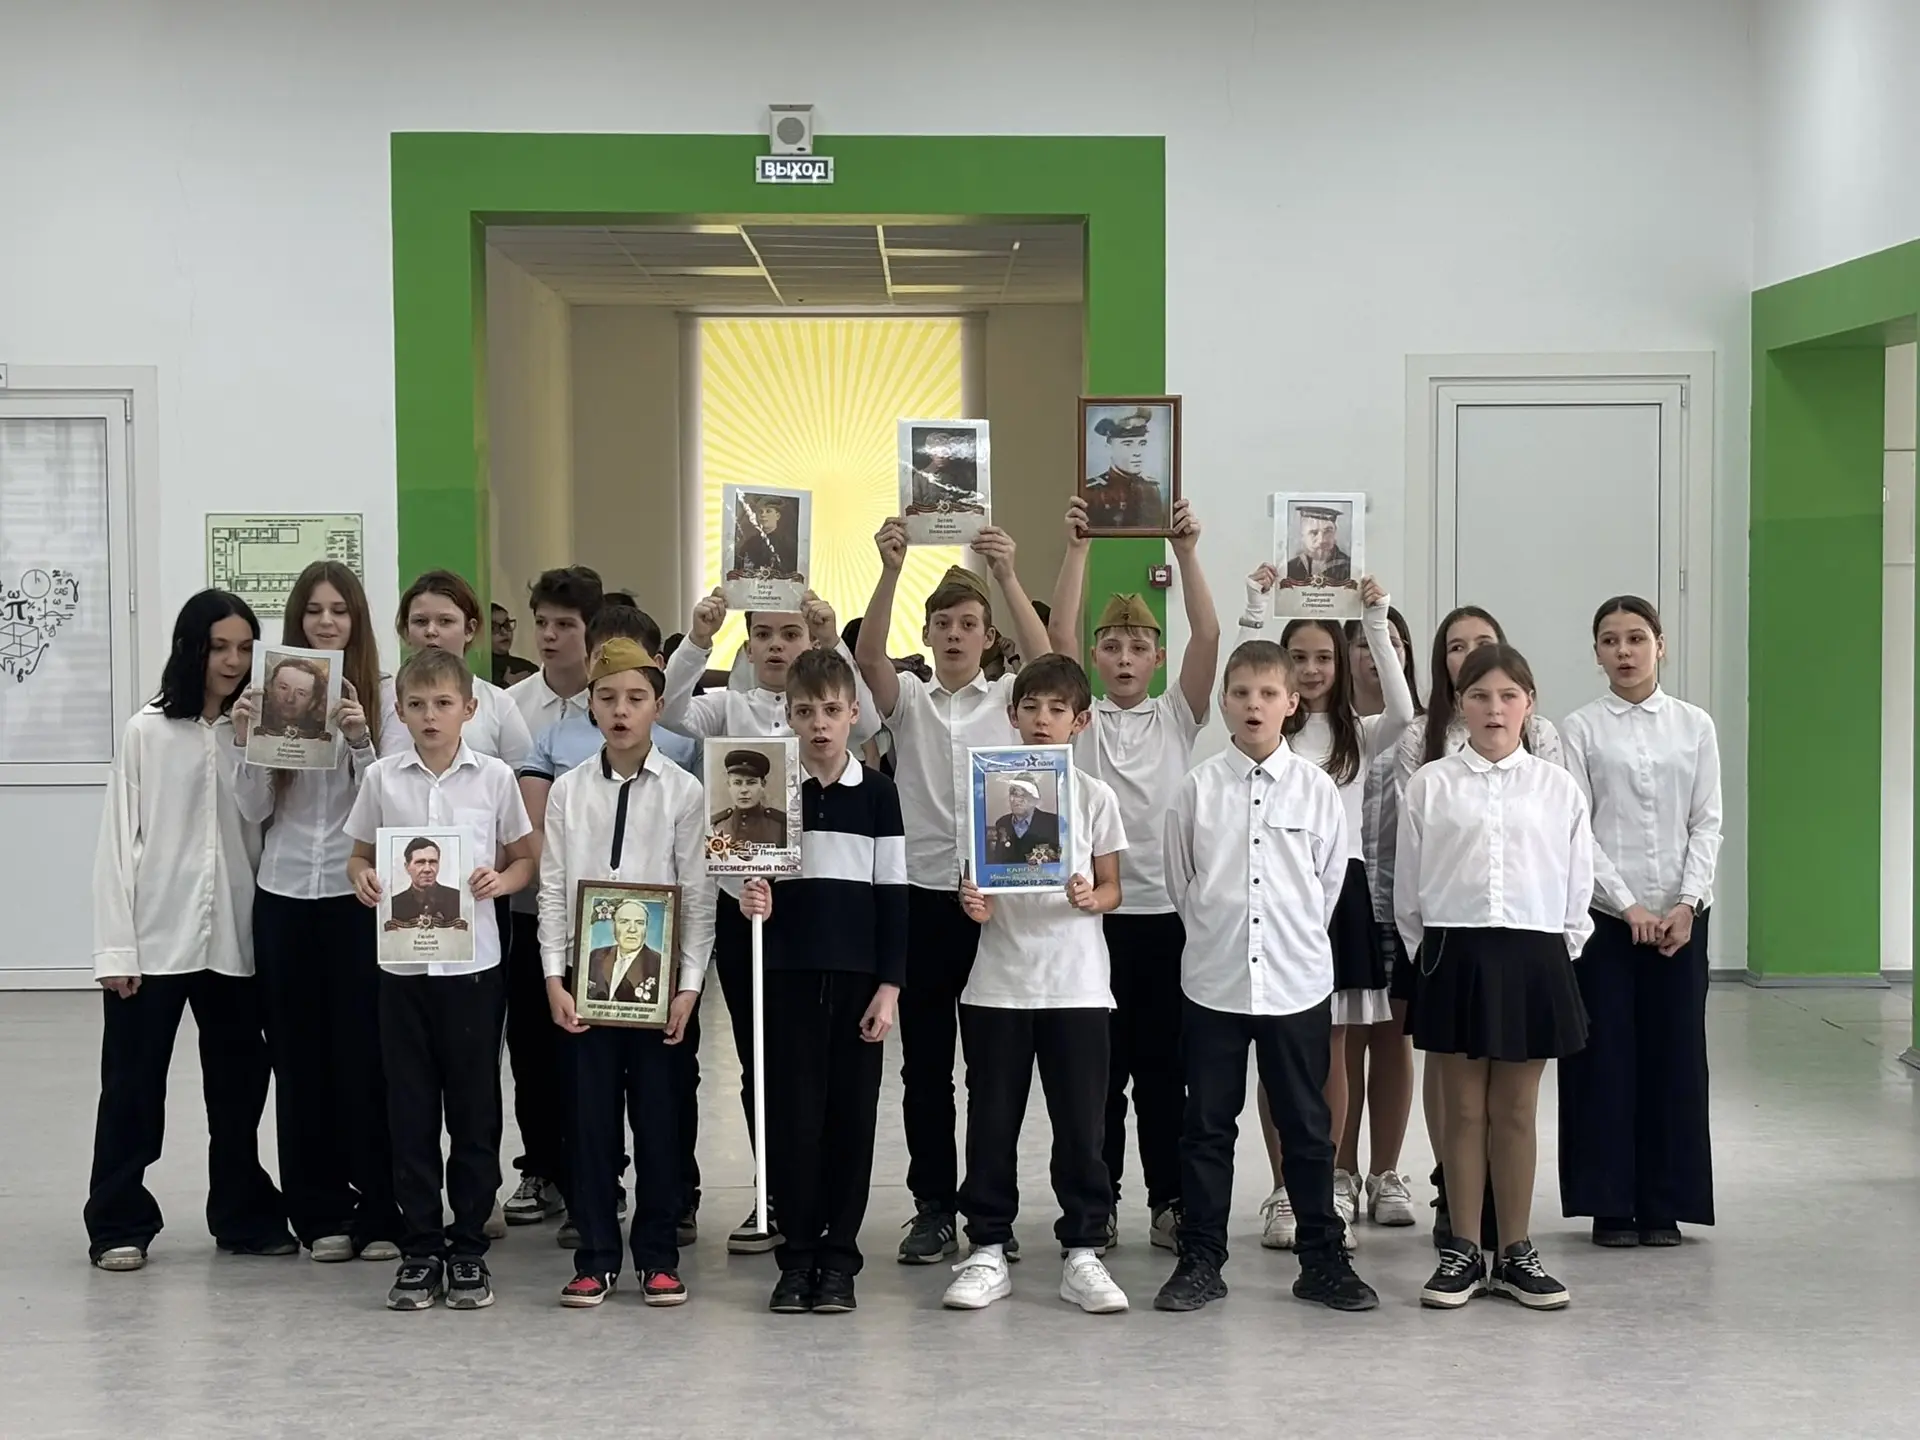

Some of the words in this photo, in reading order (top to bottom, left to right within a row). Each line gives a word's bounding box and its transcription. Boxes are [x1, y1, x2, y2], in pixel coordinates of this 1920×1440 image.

[764, 161, 826, 177] ВЫХОД
[708, 864, 772, 872] БЕССМЕРТНЫЙ
[774, 864, 798, 872] ПОЛК
